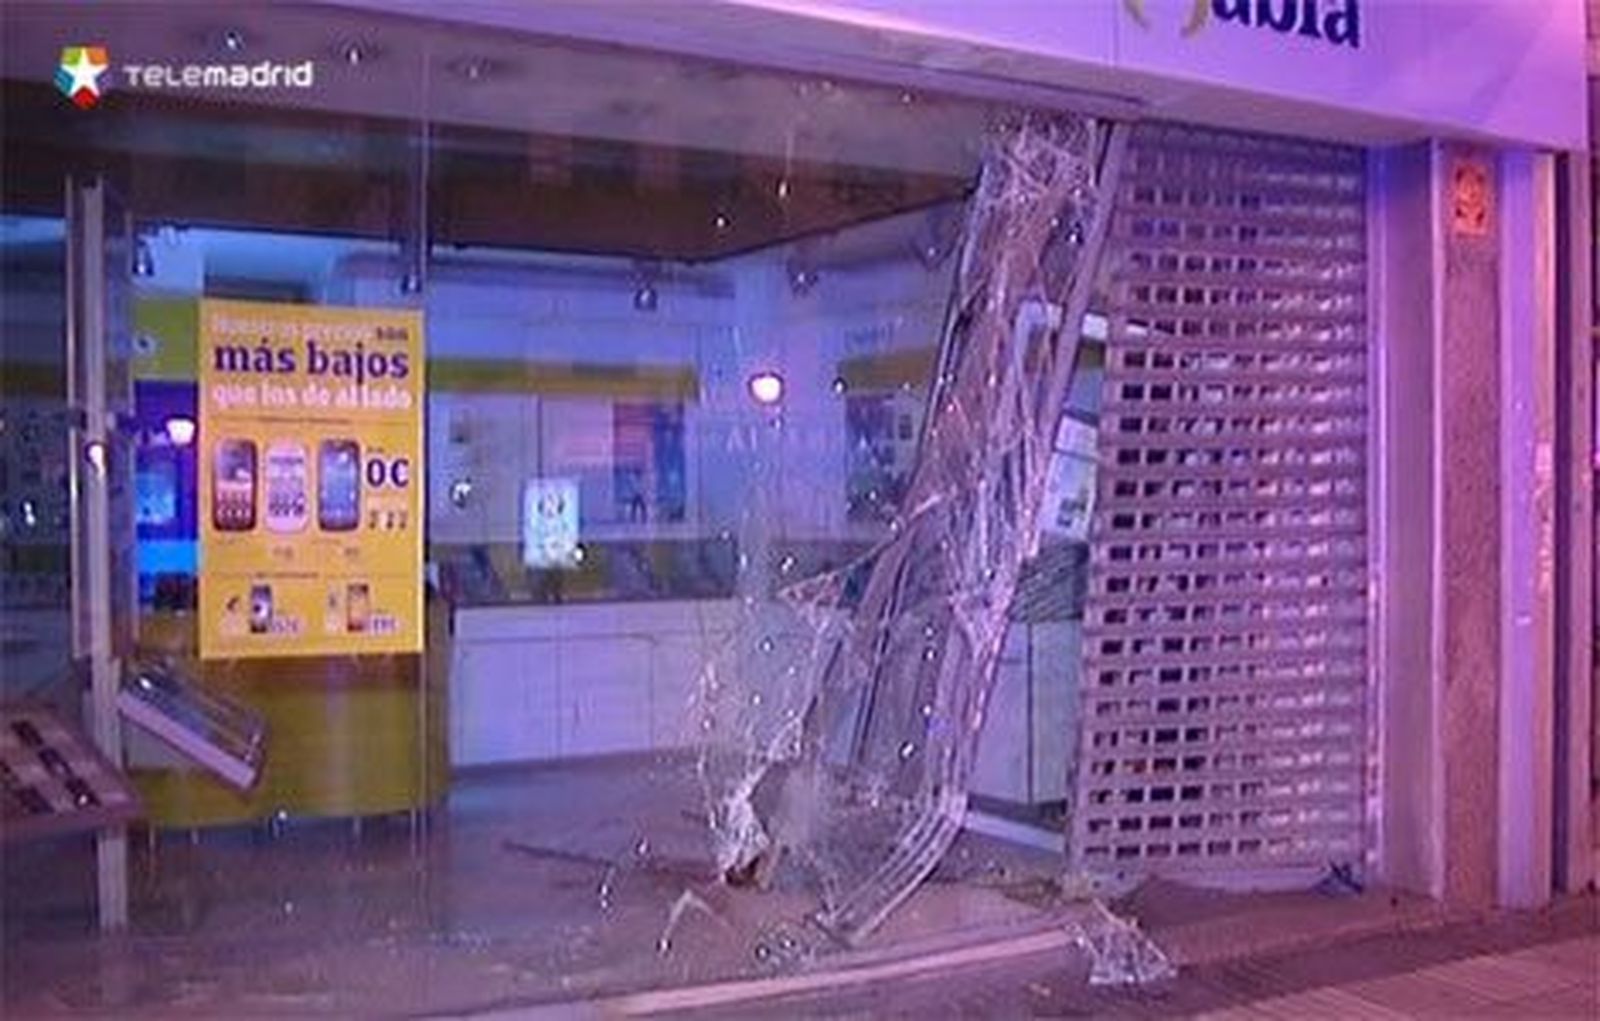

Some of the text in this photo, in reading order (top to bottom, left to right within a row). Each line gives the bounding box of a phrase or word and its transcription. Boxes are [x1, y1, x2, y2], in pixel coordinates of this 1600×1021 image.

[214, 336, 409, 386] más bajos
[213, 385, 257, 409] que
[261, 383, 299, 406] los
[301, 382, 330, 406] de
